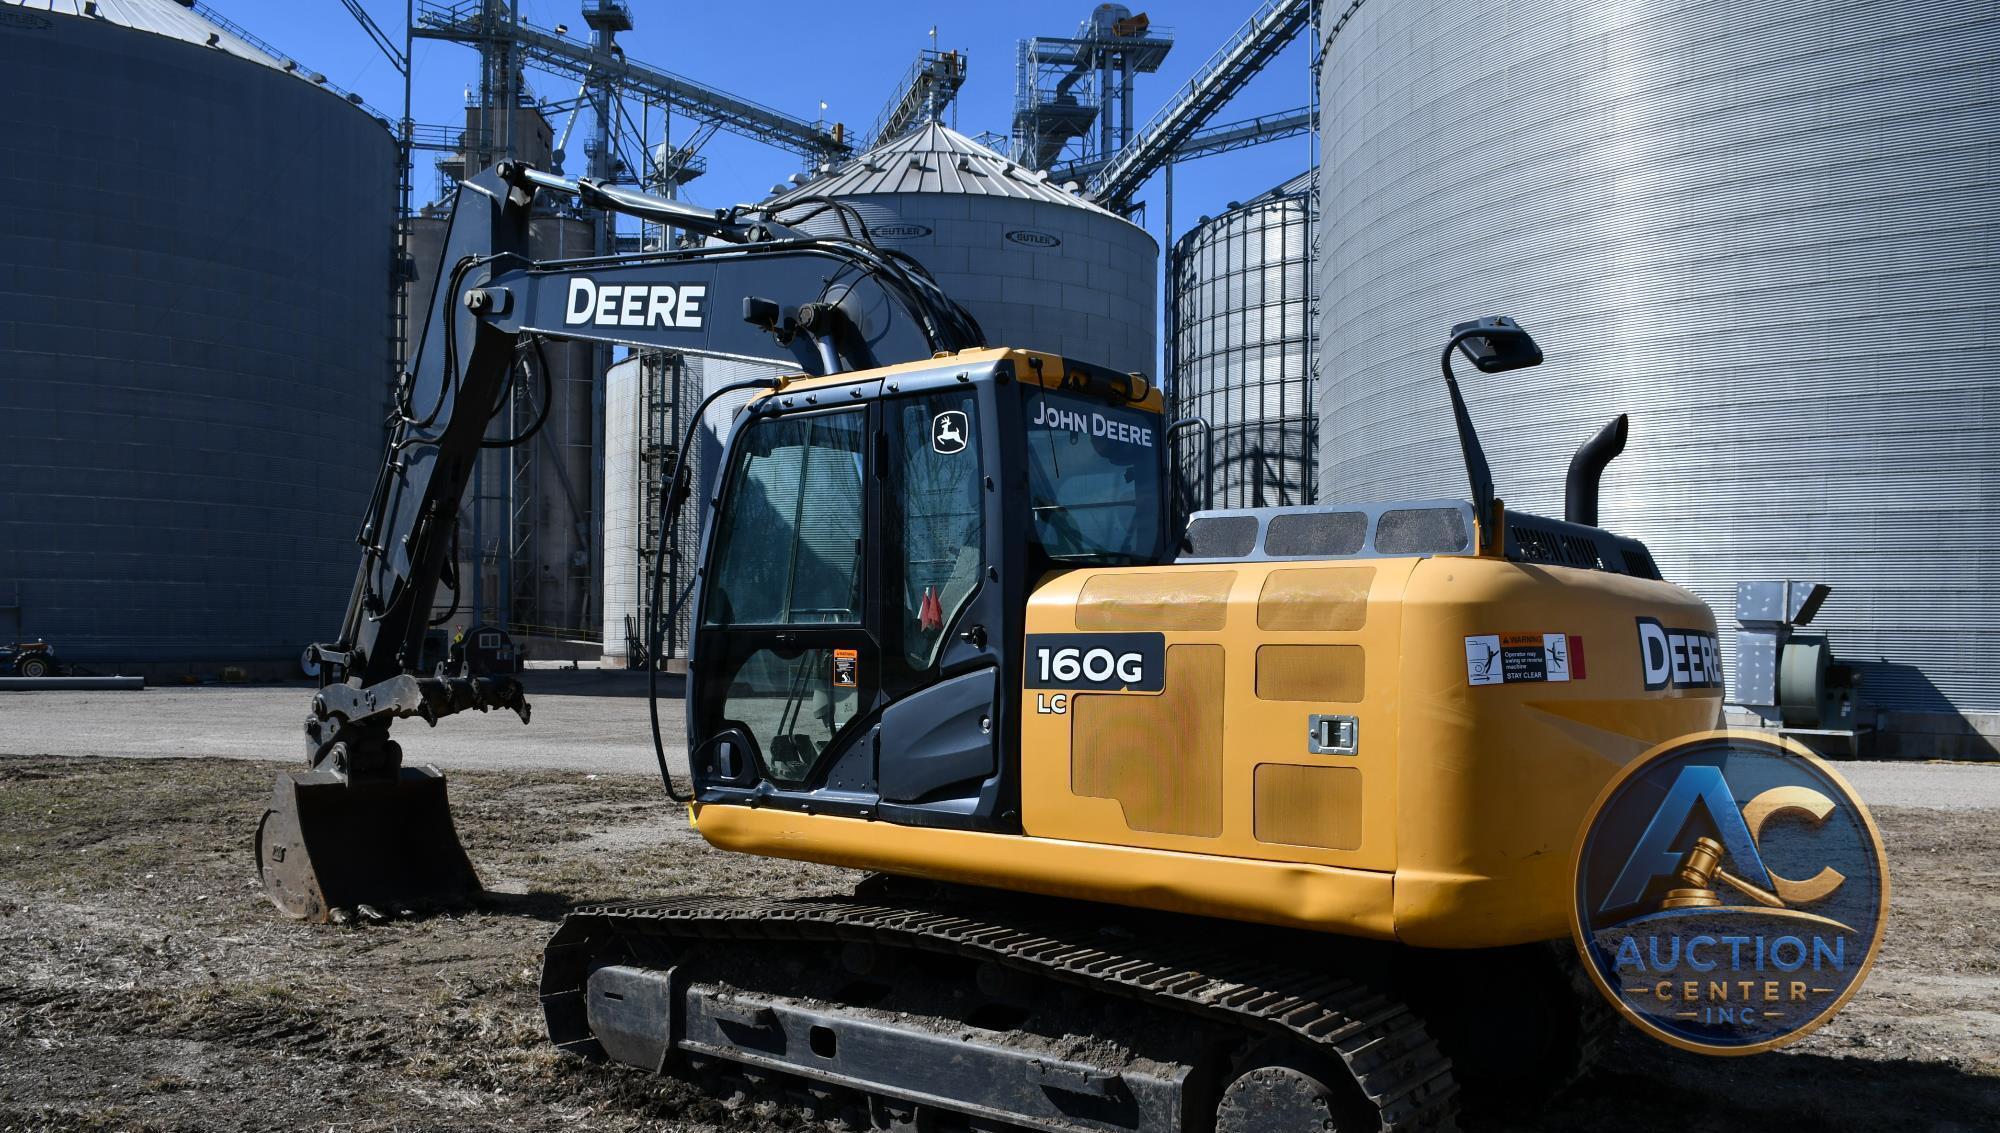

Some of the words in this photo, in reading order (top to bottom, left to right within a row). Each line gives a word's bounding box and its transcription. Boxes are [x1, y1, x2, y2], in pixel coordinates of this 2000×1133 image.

[882, 227, 919, 236] BUTLER
[1016, 233, 1050, 244] BUTLER
[566, 278, 706, 327] DEERE
[1034, 401, 1087, 434] JOHN
[1092, 413, 1153, 447] DEERE
[1510, 635, 1542, 643] WARNING
[1639, 623, 1721, 685] DEERE
[1038, 648, 1142, 682] 160G
[1507, 671, 1521, 679] STAY
[1524, 671, 1542, 679] CLEAR
[1038, 694, 1066, 714] LC
